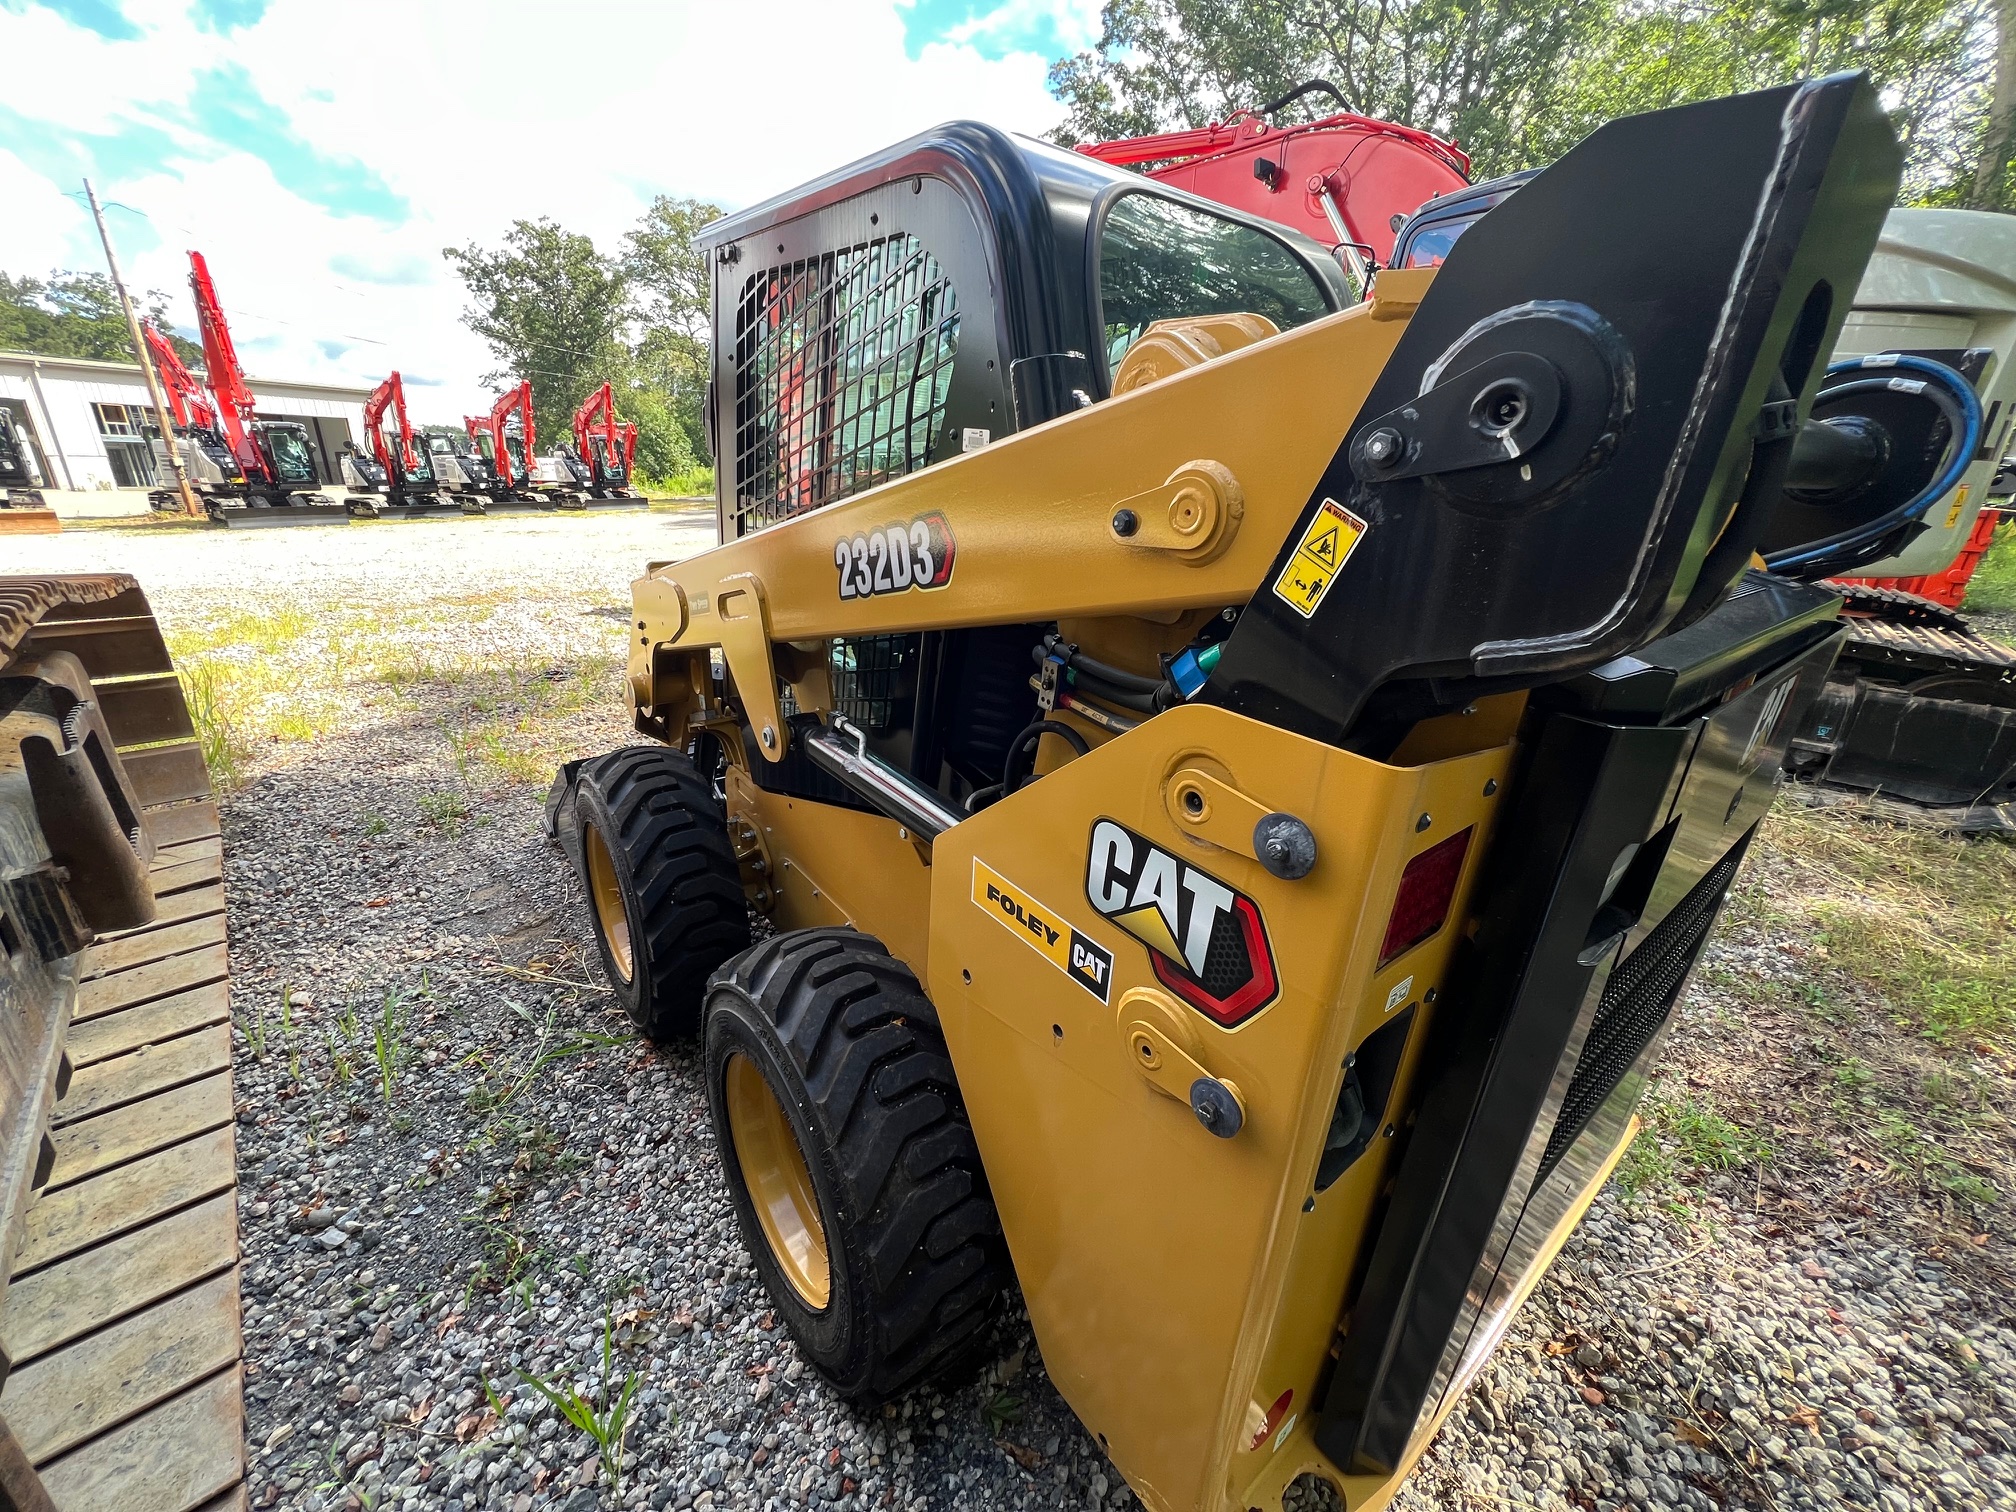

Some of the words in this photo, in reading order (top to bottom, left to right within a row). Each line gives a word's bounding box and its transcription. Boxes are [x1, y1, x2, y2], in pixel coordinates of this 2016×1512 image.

[836, 520, 934, 597] 232D3
[1332, 508, 1361, 532] WARNING
[986, 882, 1060, 947] FOLEY
[1073, 943, 1106, 985] CAT
[1088, 821, 1235, 979] CAT
